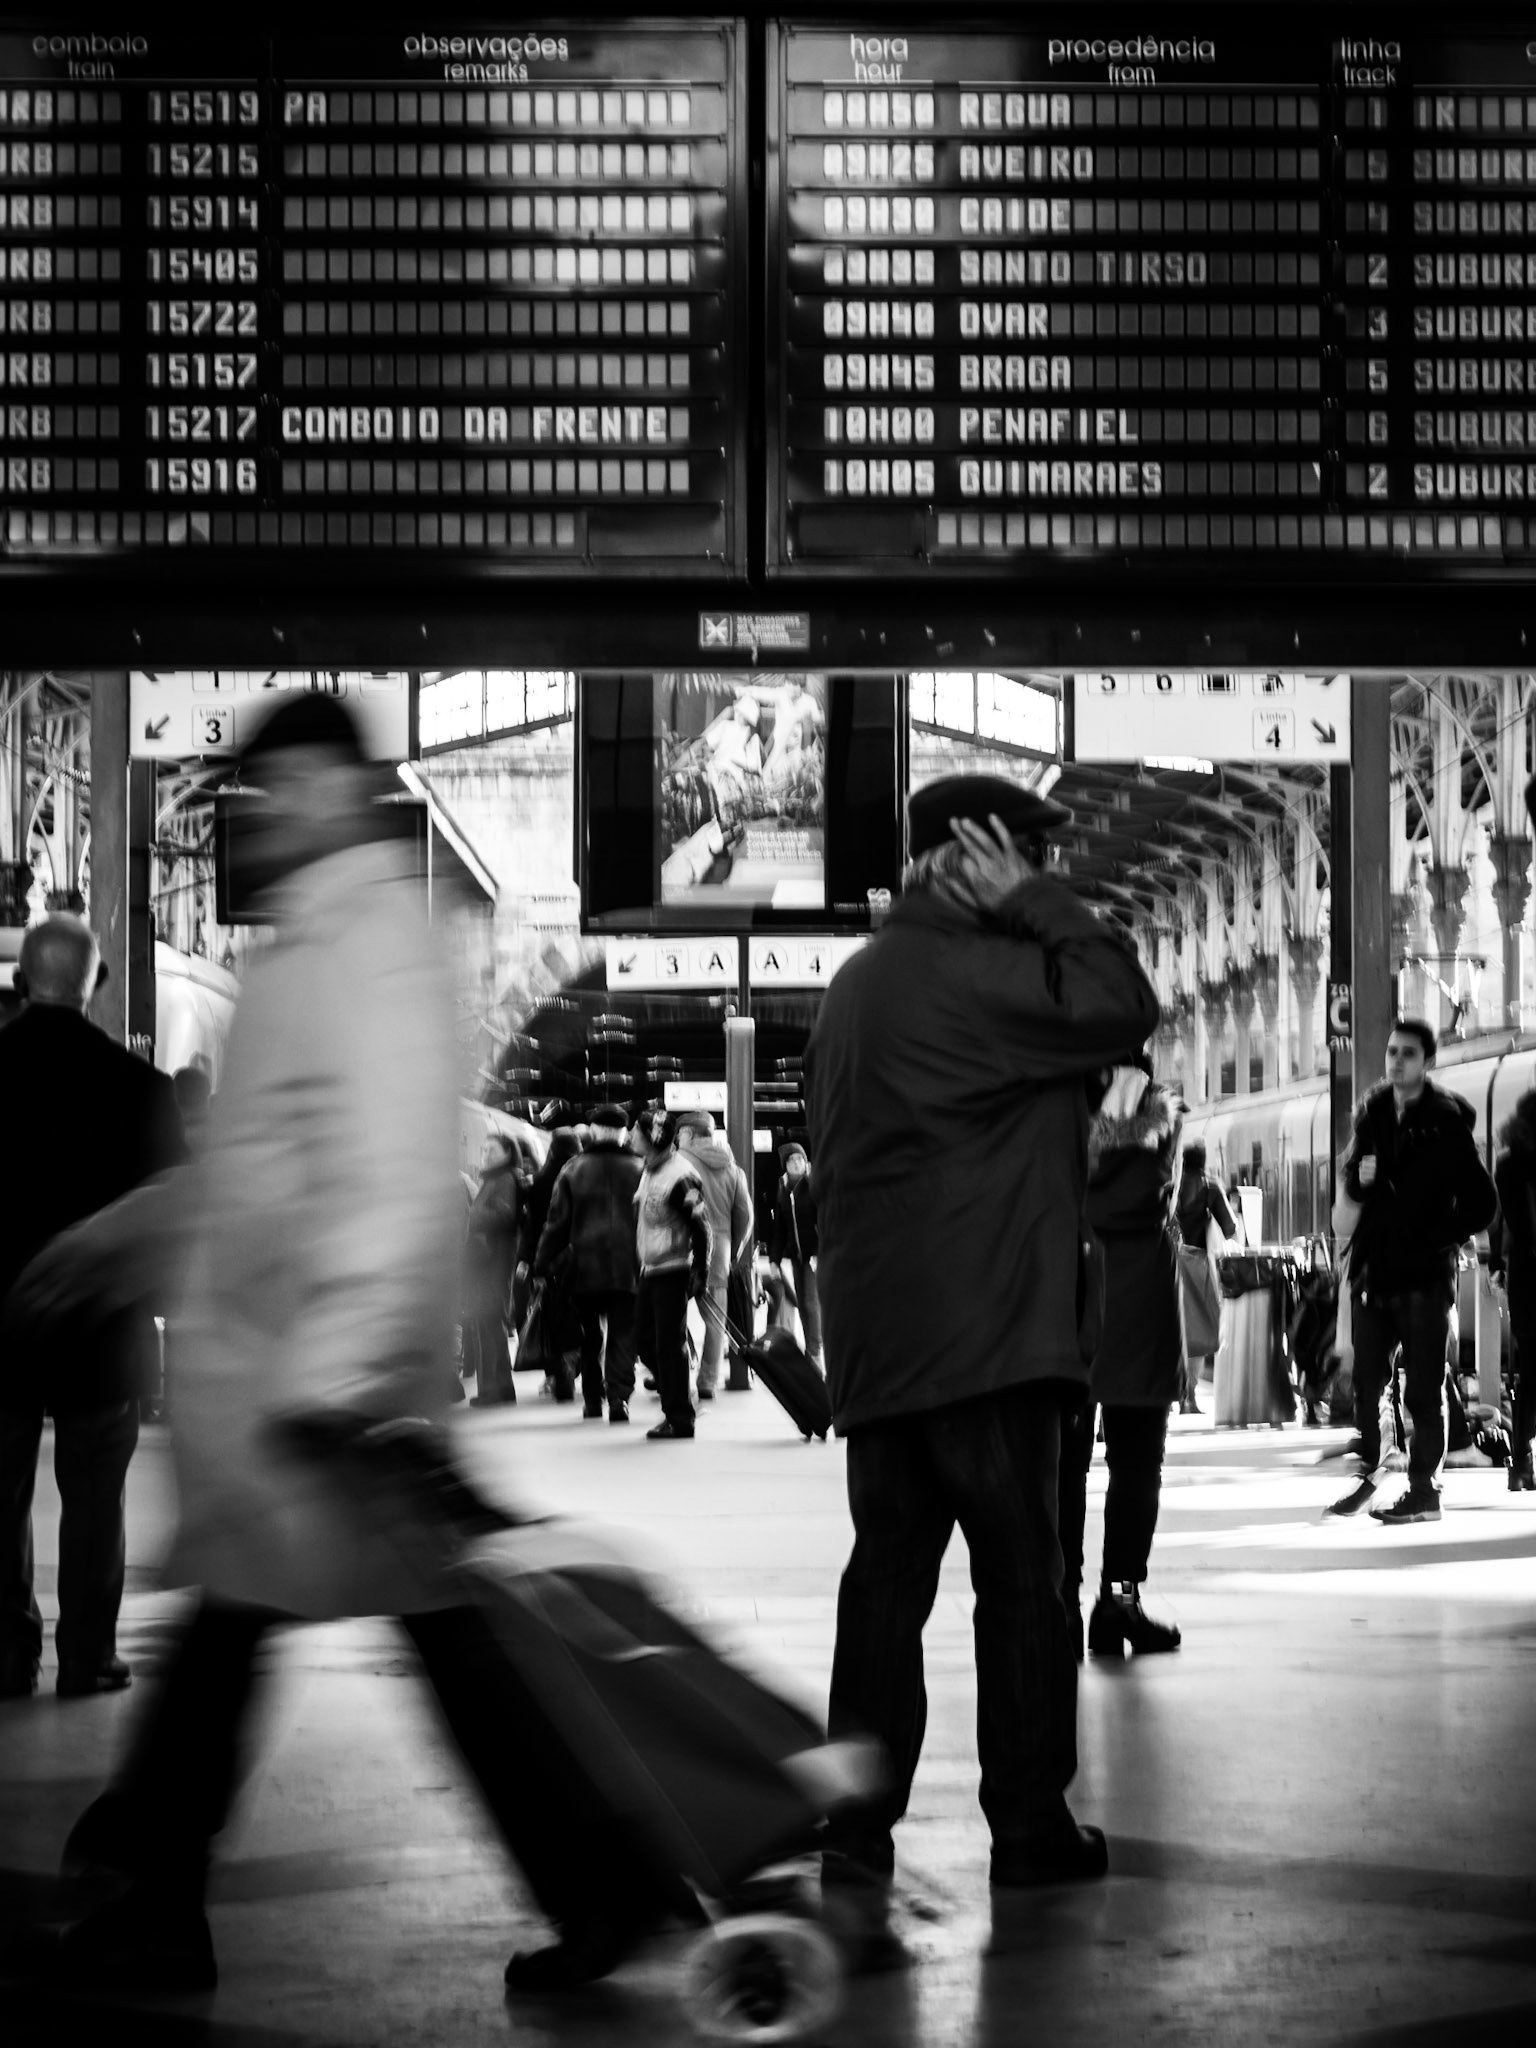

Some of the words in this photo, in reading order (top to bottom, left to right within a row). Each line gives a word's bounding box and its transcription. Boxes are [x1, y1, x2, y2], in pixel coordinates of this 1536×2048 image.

[33, 32, 147, 56] comboio
[404, 33, 568, 60] observações
[851, 34, 908, 60] hora
[1049, 35, 1215, 63] procedência
[1341, 38, 1400, 61] linha
[69, 60, 114, 80] train
[444, 61, 528, 82] remarks
[855, 60, 902, 83] hour
[1108, 63, 1155, 86] from
[1344, 65, 1396, 88] track
[150, 91, 257, 124] 15519
[284, 91, 326, 125] PA
[960, 93, 1070, 127] REGUA
[150, 144, 257, 177] 15215
[960, 146, 1093, 180] AVEIRO
[150, 196, 257, 229] 15914
[150, 249, 257, 282] 15405
[960, 251, 1070, 286] SANTO
[1096, 251, 1207, 286] TIRSO
[1368, 254, 1387, 289] 2
[147, 301, 257, 335] 15722
[824, 302, 934, 337] 09H40
[960, 303, 1048, 338] OVAR
[147, 353, 257, 387] 15157
[824, 354, 934, 389] 09H45
[960, 355, 1071, 390] BRAGA
[1368, 359, 1387, 393] 5
[147, 406, 257, 440] 15217
[282, 406, 439, 441] COMBOIO
[465, 406, 507, 441] DA
[533, 406, 666, 442] FRENTE
[824, 407, 934, 442] 10H00
[960, 408, 1138, 443] PENAFIEL
[147, 458, 257, 492] 15916
[824, 459, 934, 494] 10H05
[960, 460, 1162, 495] GUIMARAES
[1368, 463, 1387, 497] 2
[205, 719, 222, 744] 3
[1264, 723, 1281, 748] 4
[666, 954, 679, 975] 3
[708, 951, 724, 970] A
[764, 951, 780, 970] A
[809, 954, 821, 974] 4
[1330, 996, 1350, 1034] C
